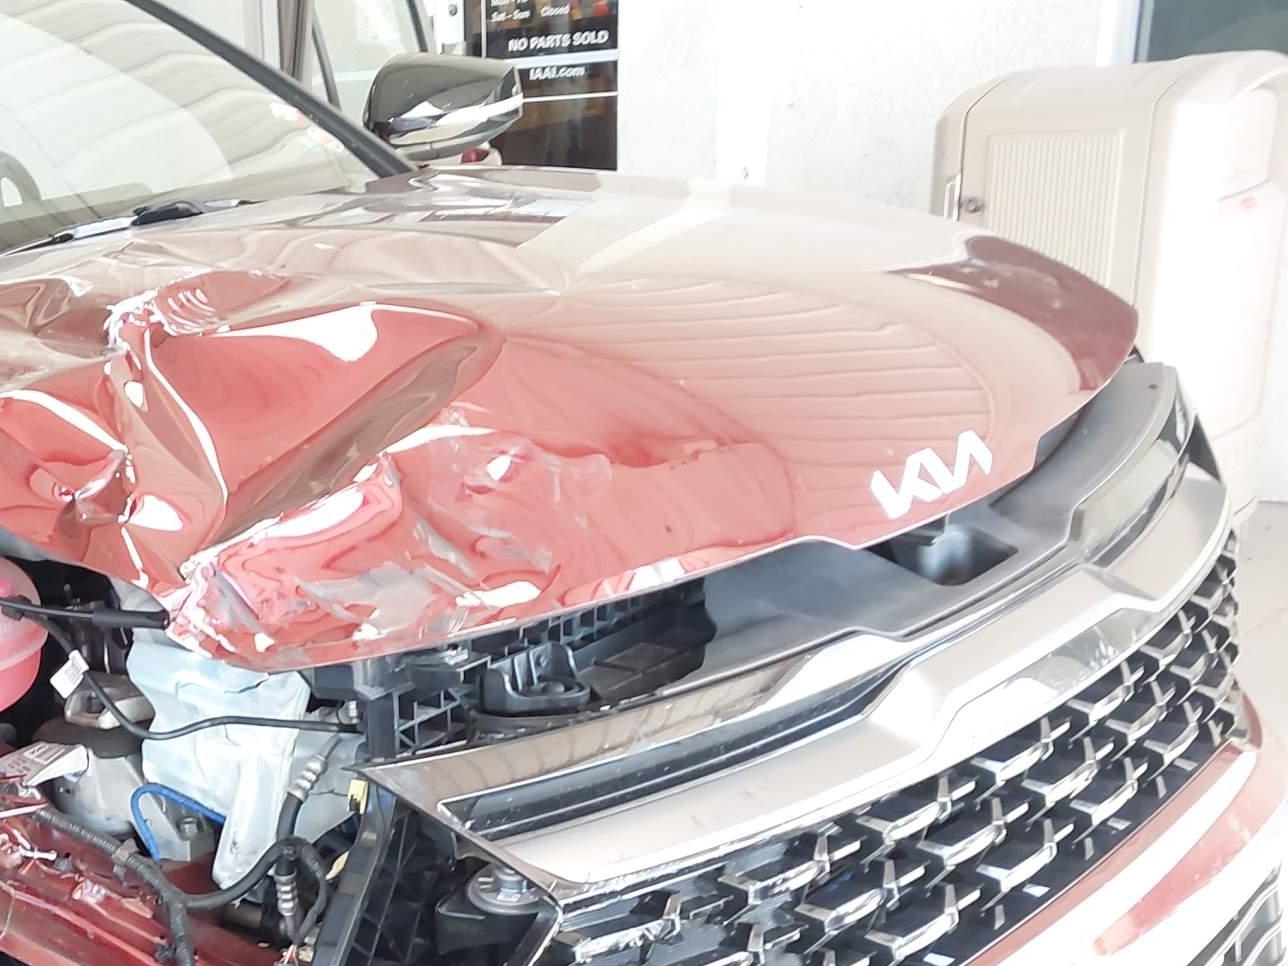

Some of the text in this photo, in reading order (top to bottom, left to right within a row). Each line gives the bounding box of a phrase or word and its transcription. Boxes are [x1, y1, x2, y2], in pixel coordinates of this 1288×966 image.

[508, 30, 609, 52] NO PARTS SOLD
[870, 429, 993, 519] KIA
